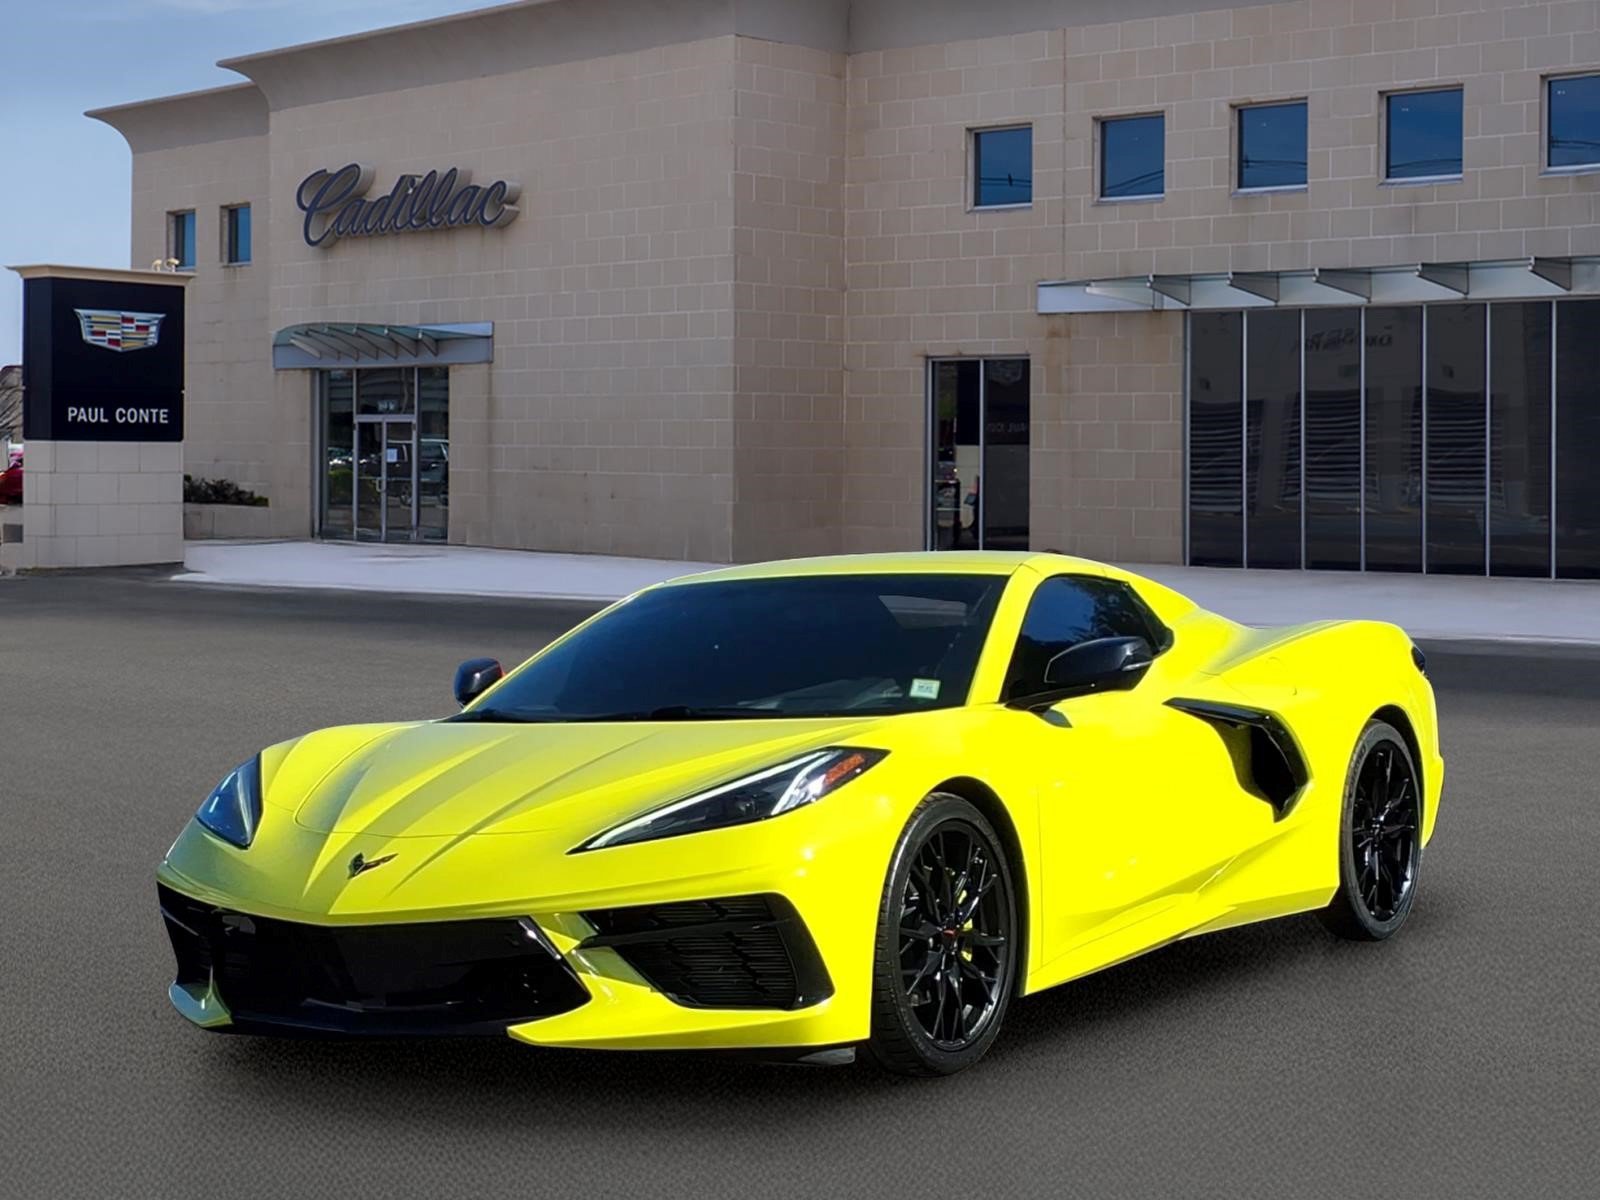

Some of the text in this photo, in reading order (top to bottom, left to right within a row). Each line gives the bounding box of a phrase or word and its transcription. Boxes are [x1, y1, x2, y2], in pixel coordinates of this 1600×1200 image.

[296, 163, 514, 247] Cadillac
[67, 406, 169, 424] PAUL CONTE
